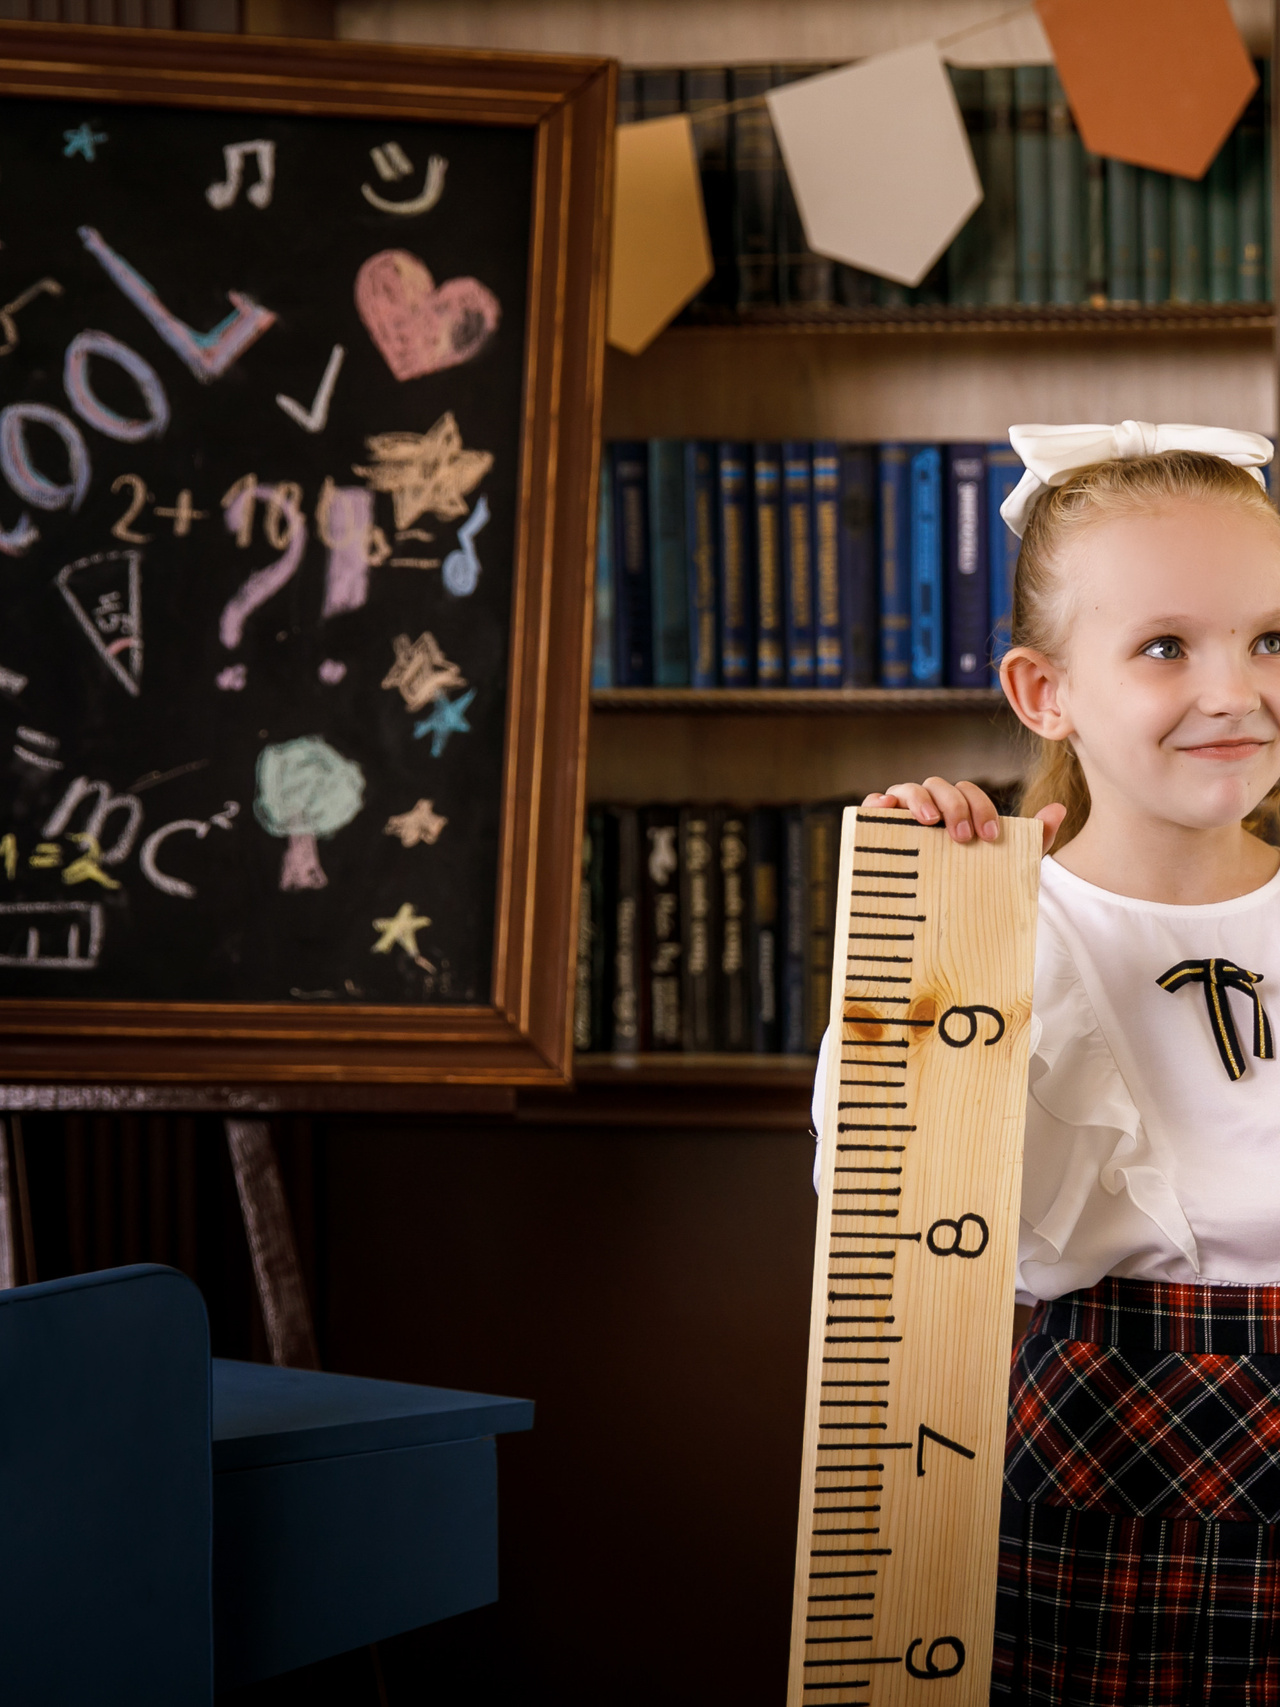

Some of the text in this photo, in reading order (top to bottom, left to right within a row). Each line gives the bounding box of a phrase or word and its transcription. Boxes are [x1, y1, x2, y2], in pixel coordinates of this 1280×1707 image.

[938, 1003, 1006, 1049] 9
[925, 1211, 991, 1260] 8
[915, 1422, 976, 1478] 7
[904, 1636, 967, 1682] 6
